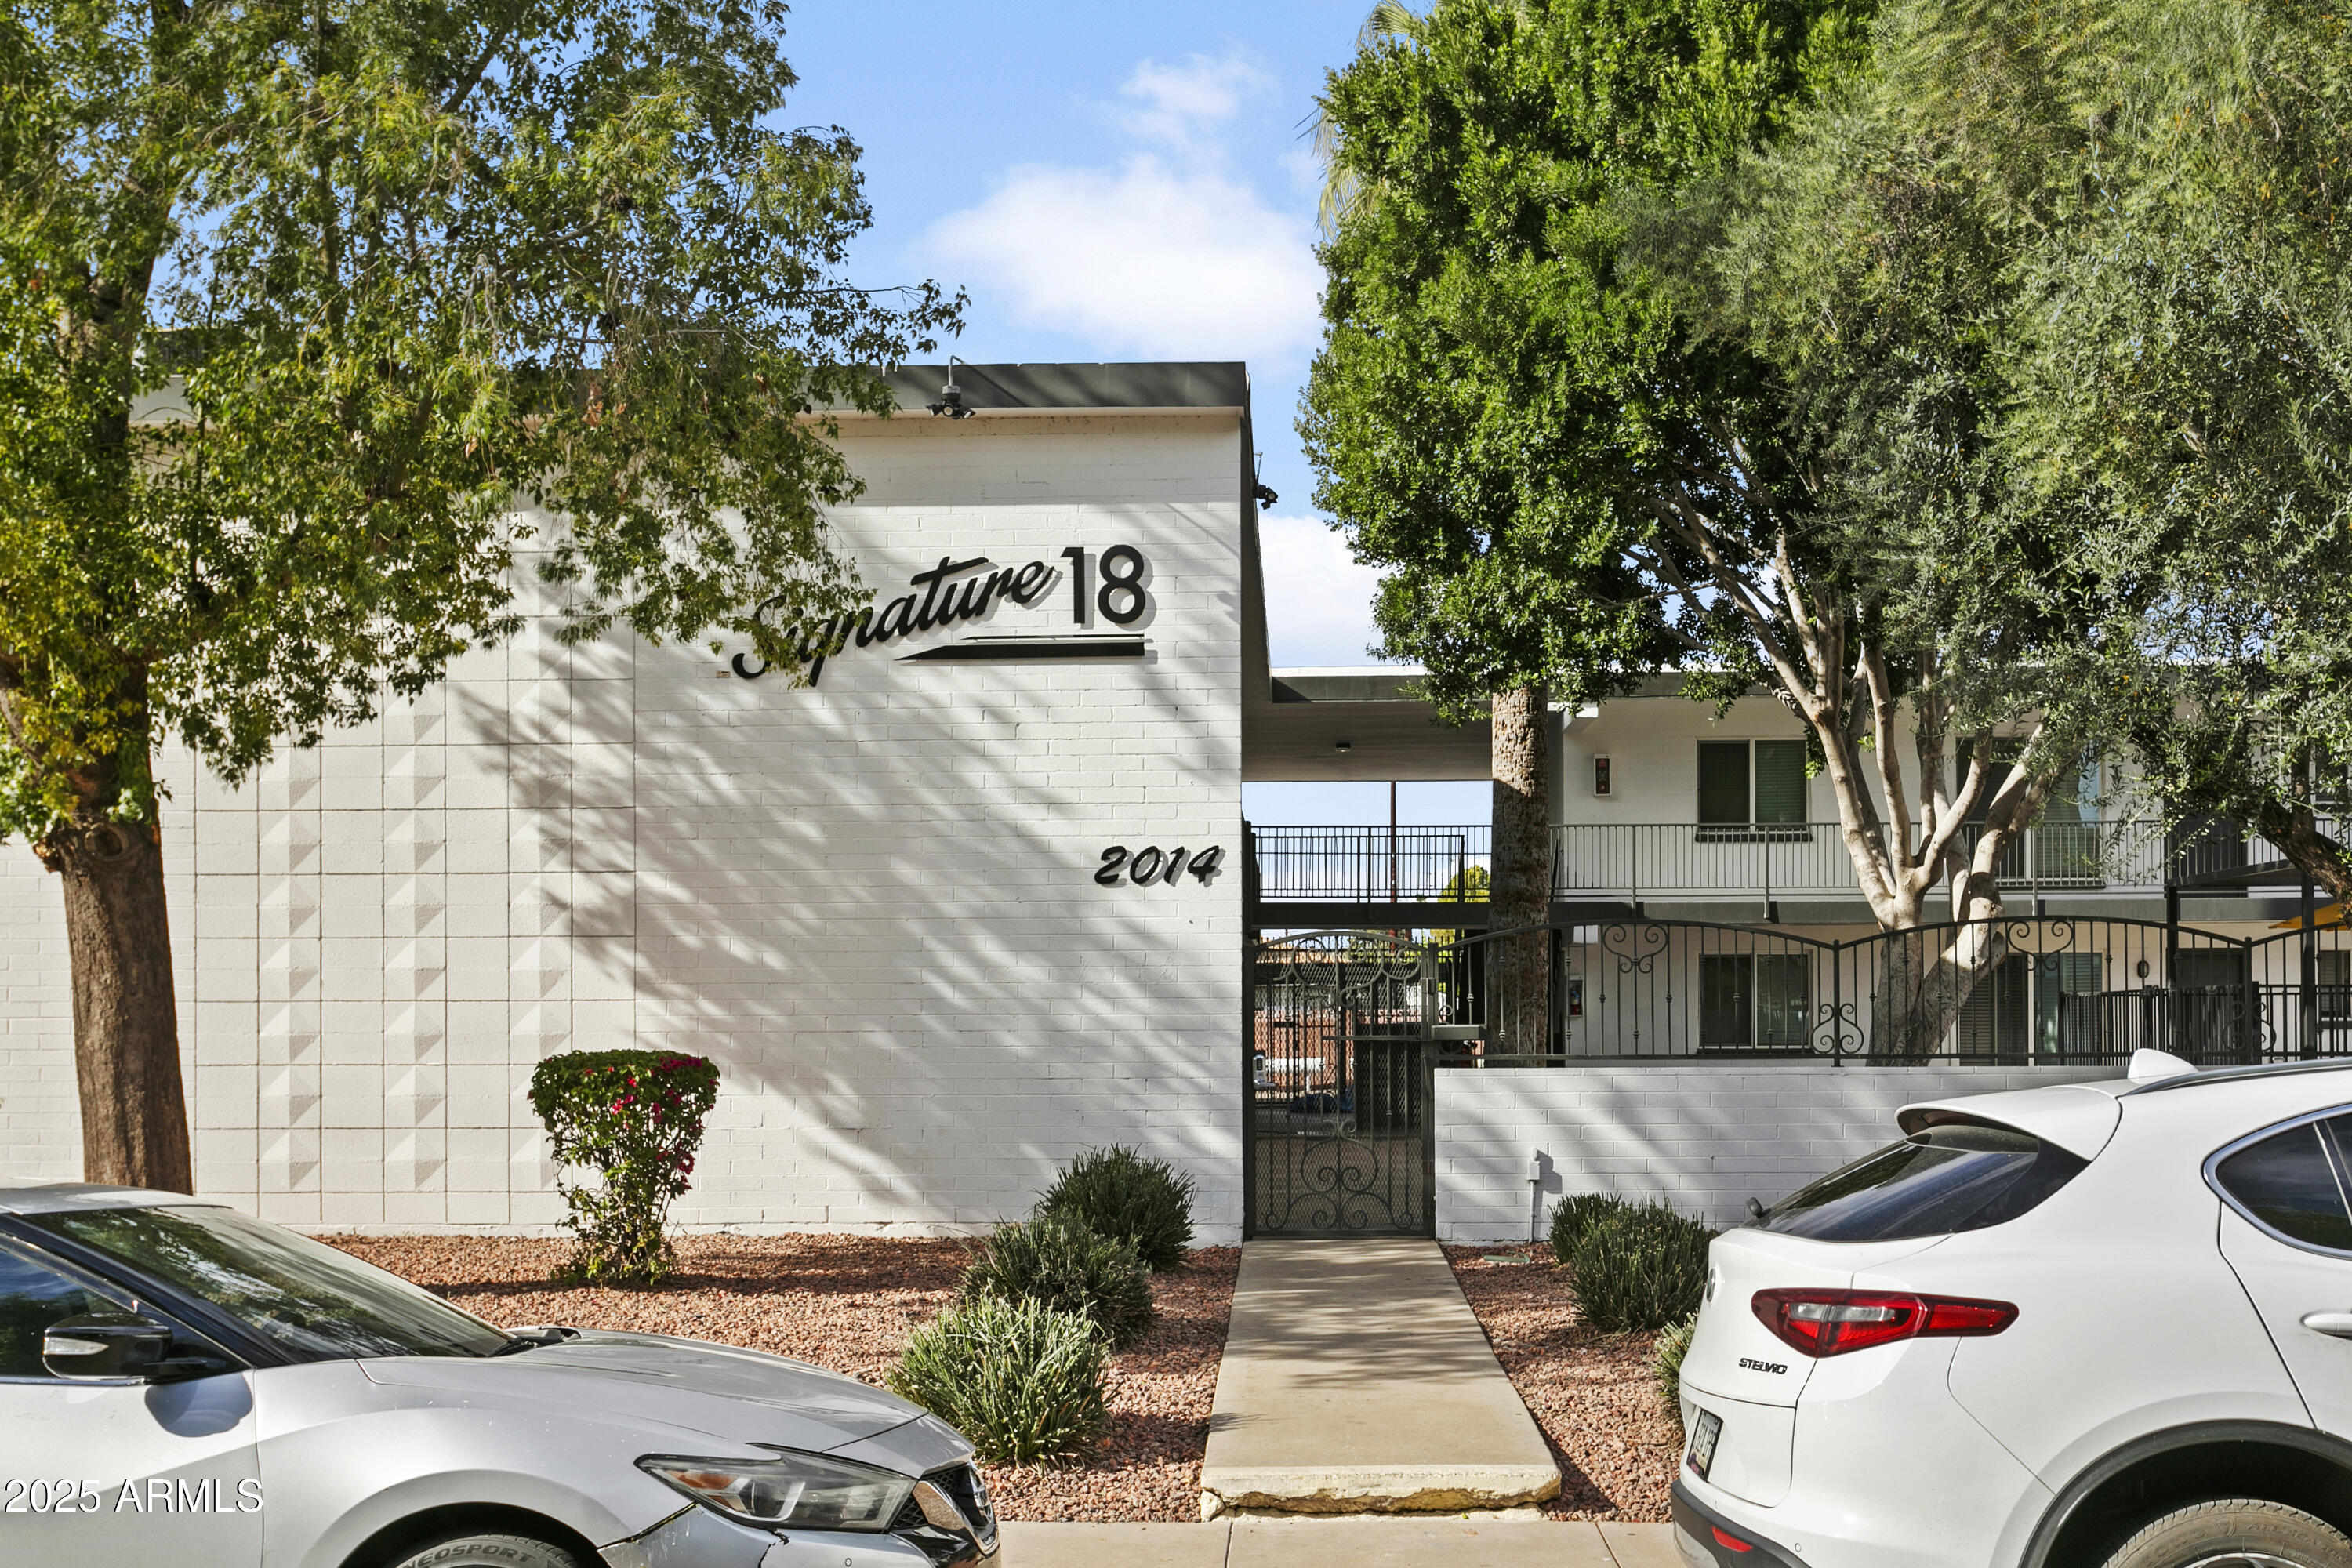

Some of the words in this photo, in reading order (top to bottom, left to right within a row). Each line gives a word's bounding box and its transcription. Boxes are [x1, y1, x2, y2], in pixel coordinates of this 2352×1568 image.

[1061, 544, 1146, 625] 18
[1094, 845, 1219, 884] 2014
[1739, 1357, 1788, 1375] STELVIO
